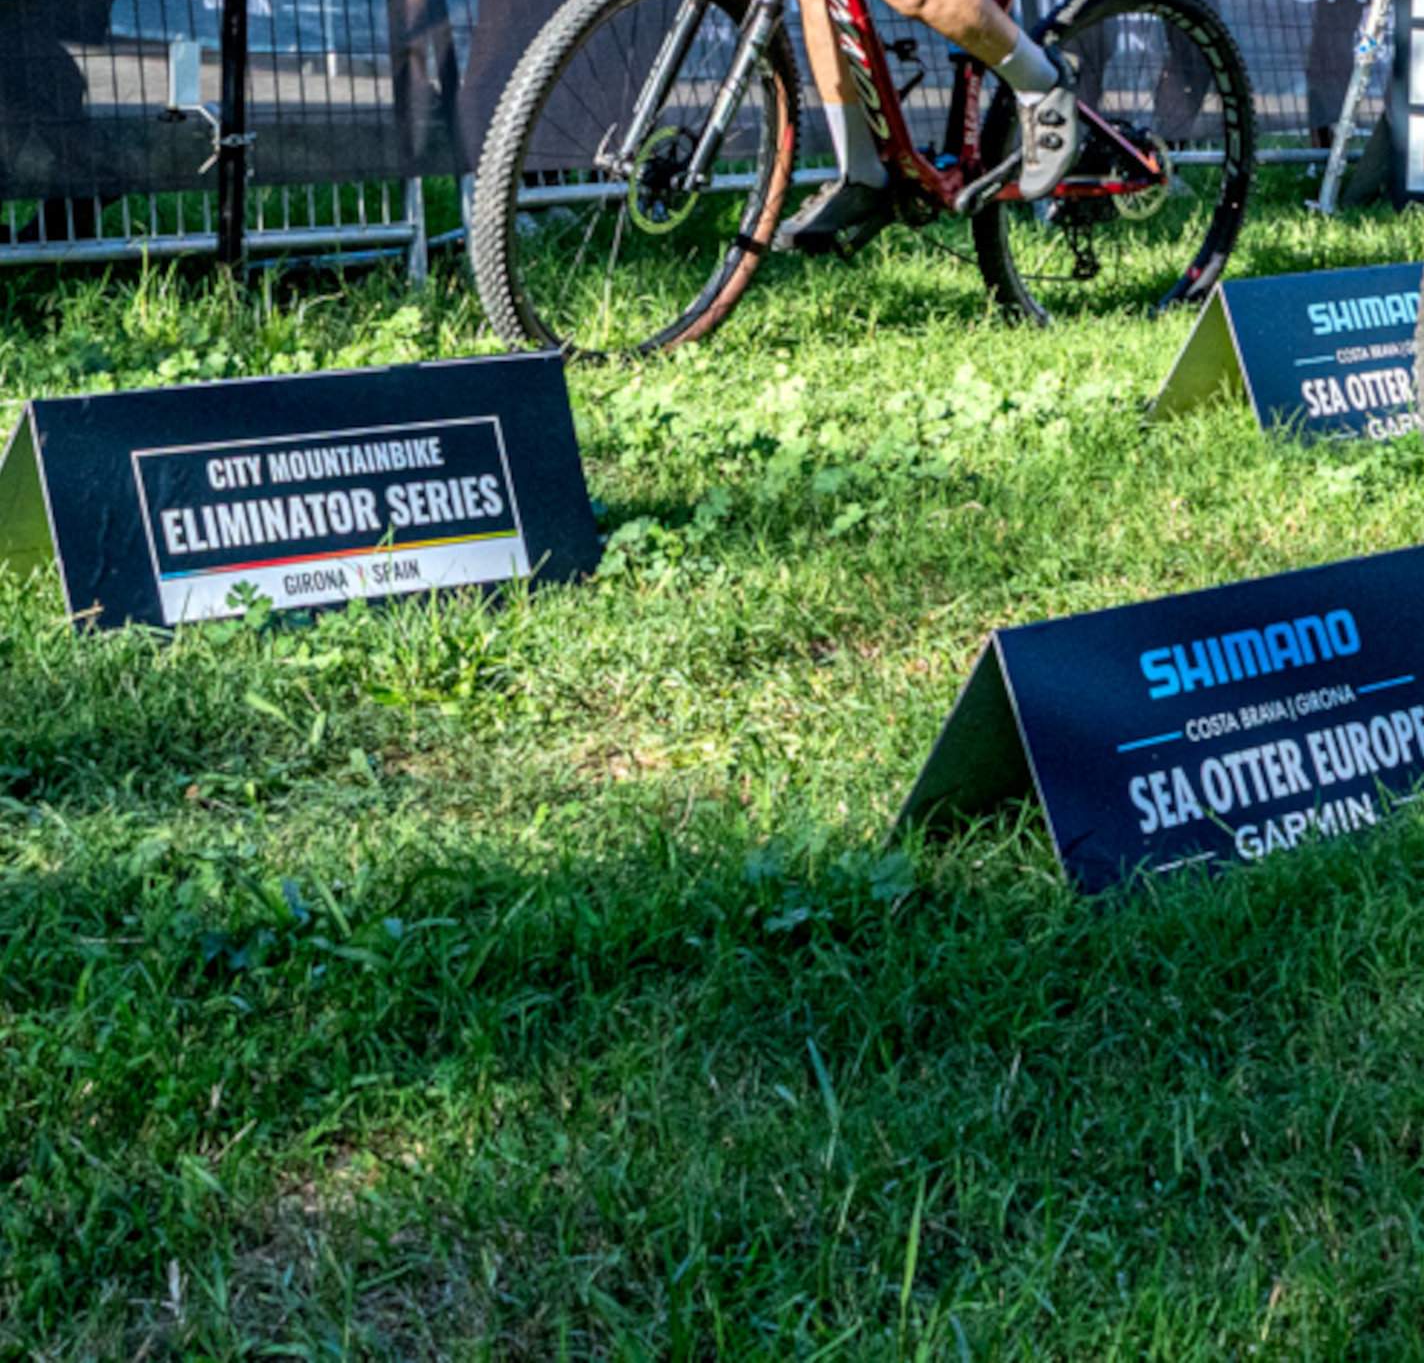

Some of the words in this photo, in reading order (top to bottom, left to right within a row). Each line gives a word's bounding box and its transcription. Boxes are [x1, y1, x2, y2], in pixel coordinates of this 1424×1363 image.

[1307, 291, 1422, 335] SHIMAN
[1302, 378, 1348, 418] SEA
[1349, 368, 1415, 411] OTTER
[206, 453, 263, 492] CITY
[268, 437, 444, 483] MOUNTAINBIKE
[161, 488, 380, 555] ELIMINATOR
[386, 473, 503, 528] SERIES
[283, 569, 350, 597] GIRONA
[373, 558, 421, 586] SPAIN
[1140, 608, 1361, 699] SHIMANO
[1185, 712, 1240, 743] COSTA
[1237, 699, 1290, 735] BRAVA
[1295, 683, 1357, 719] GIRONA
[1129, 768, 1203, 834] SEA
[1201, 735, 1306, 816] OTTER
[1235, 792, 1378, 862] GARMIN
